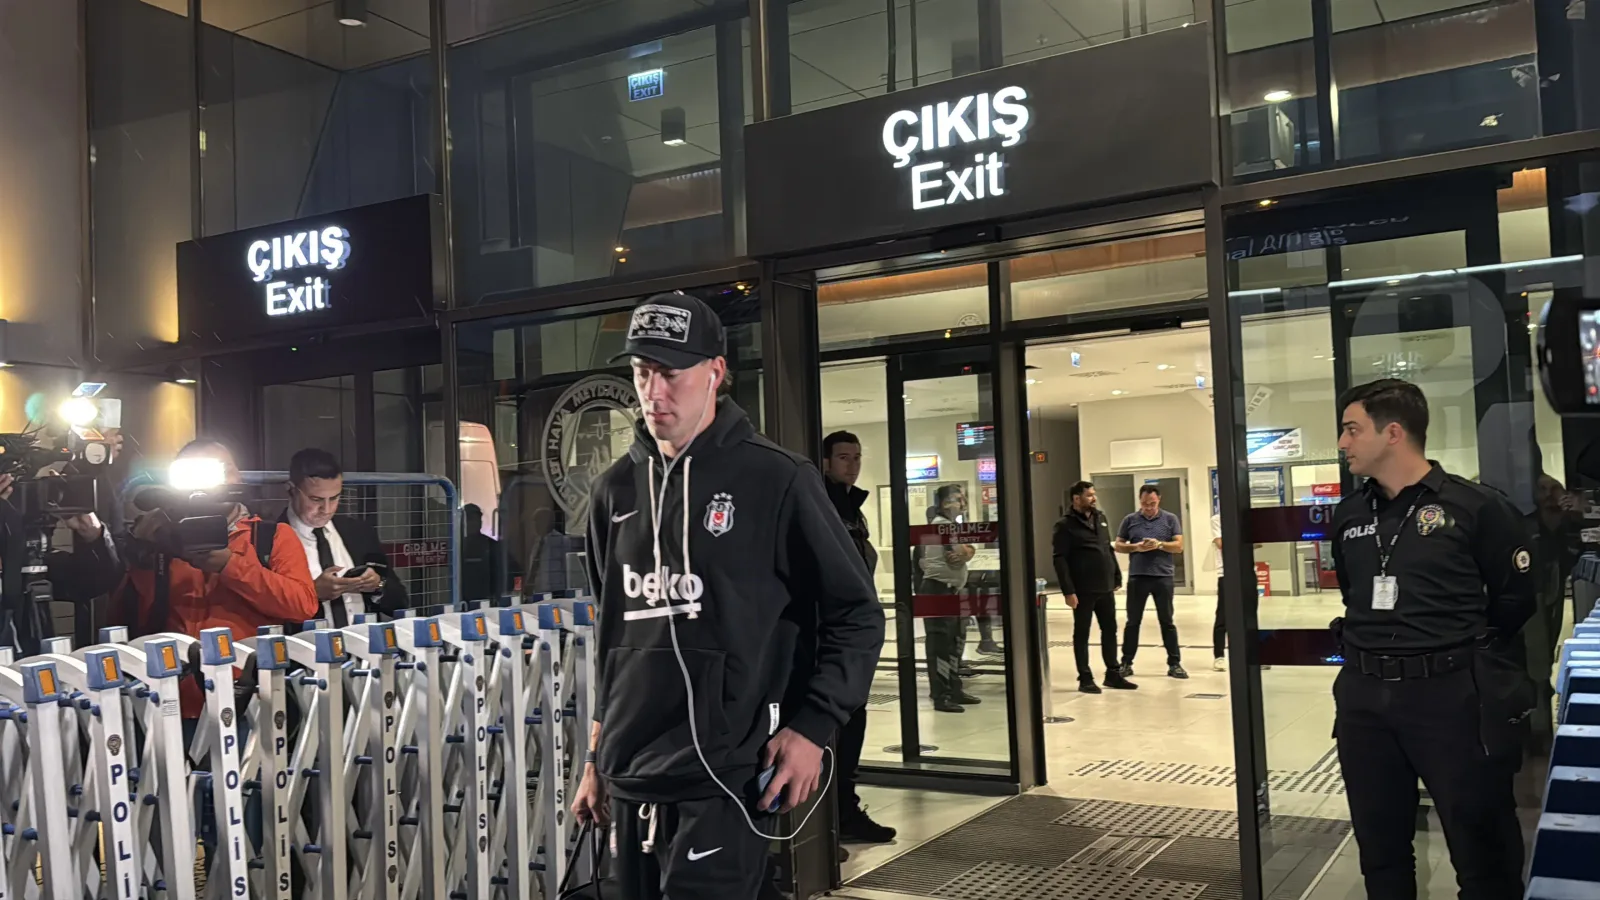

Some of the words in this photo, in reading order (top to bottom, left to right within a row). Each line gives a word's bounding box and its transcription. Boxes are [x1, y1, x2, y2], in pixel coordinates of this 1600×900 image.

[630, 73, 659, 89] ÇIKIŞ
[633, 86, 658, 99] EXIT
[881, 86, 1030, 169] ÇIKIŞ
[911, 152, 1004, 211] Exit
[247, 226, 344, 282] ÇIKIŞ
[266, 276, 325, 316] Exit
[1343, 523, 1376, 542] POLiS
[623, 564, 704, 600] beko
[477, 697, 487, 830] POLİS
[553, 682, 564, 804] POLİS
[223, 735, 246, 897] POLİS
[275, 736, 289, 892] POLİS
[384, 716, 396, 859] POLİS
